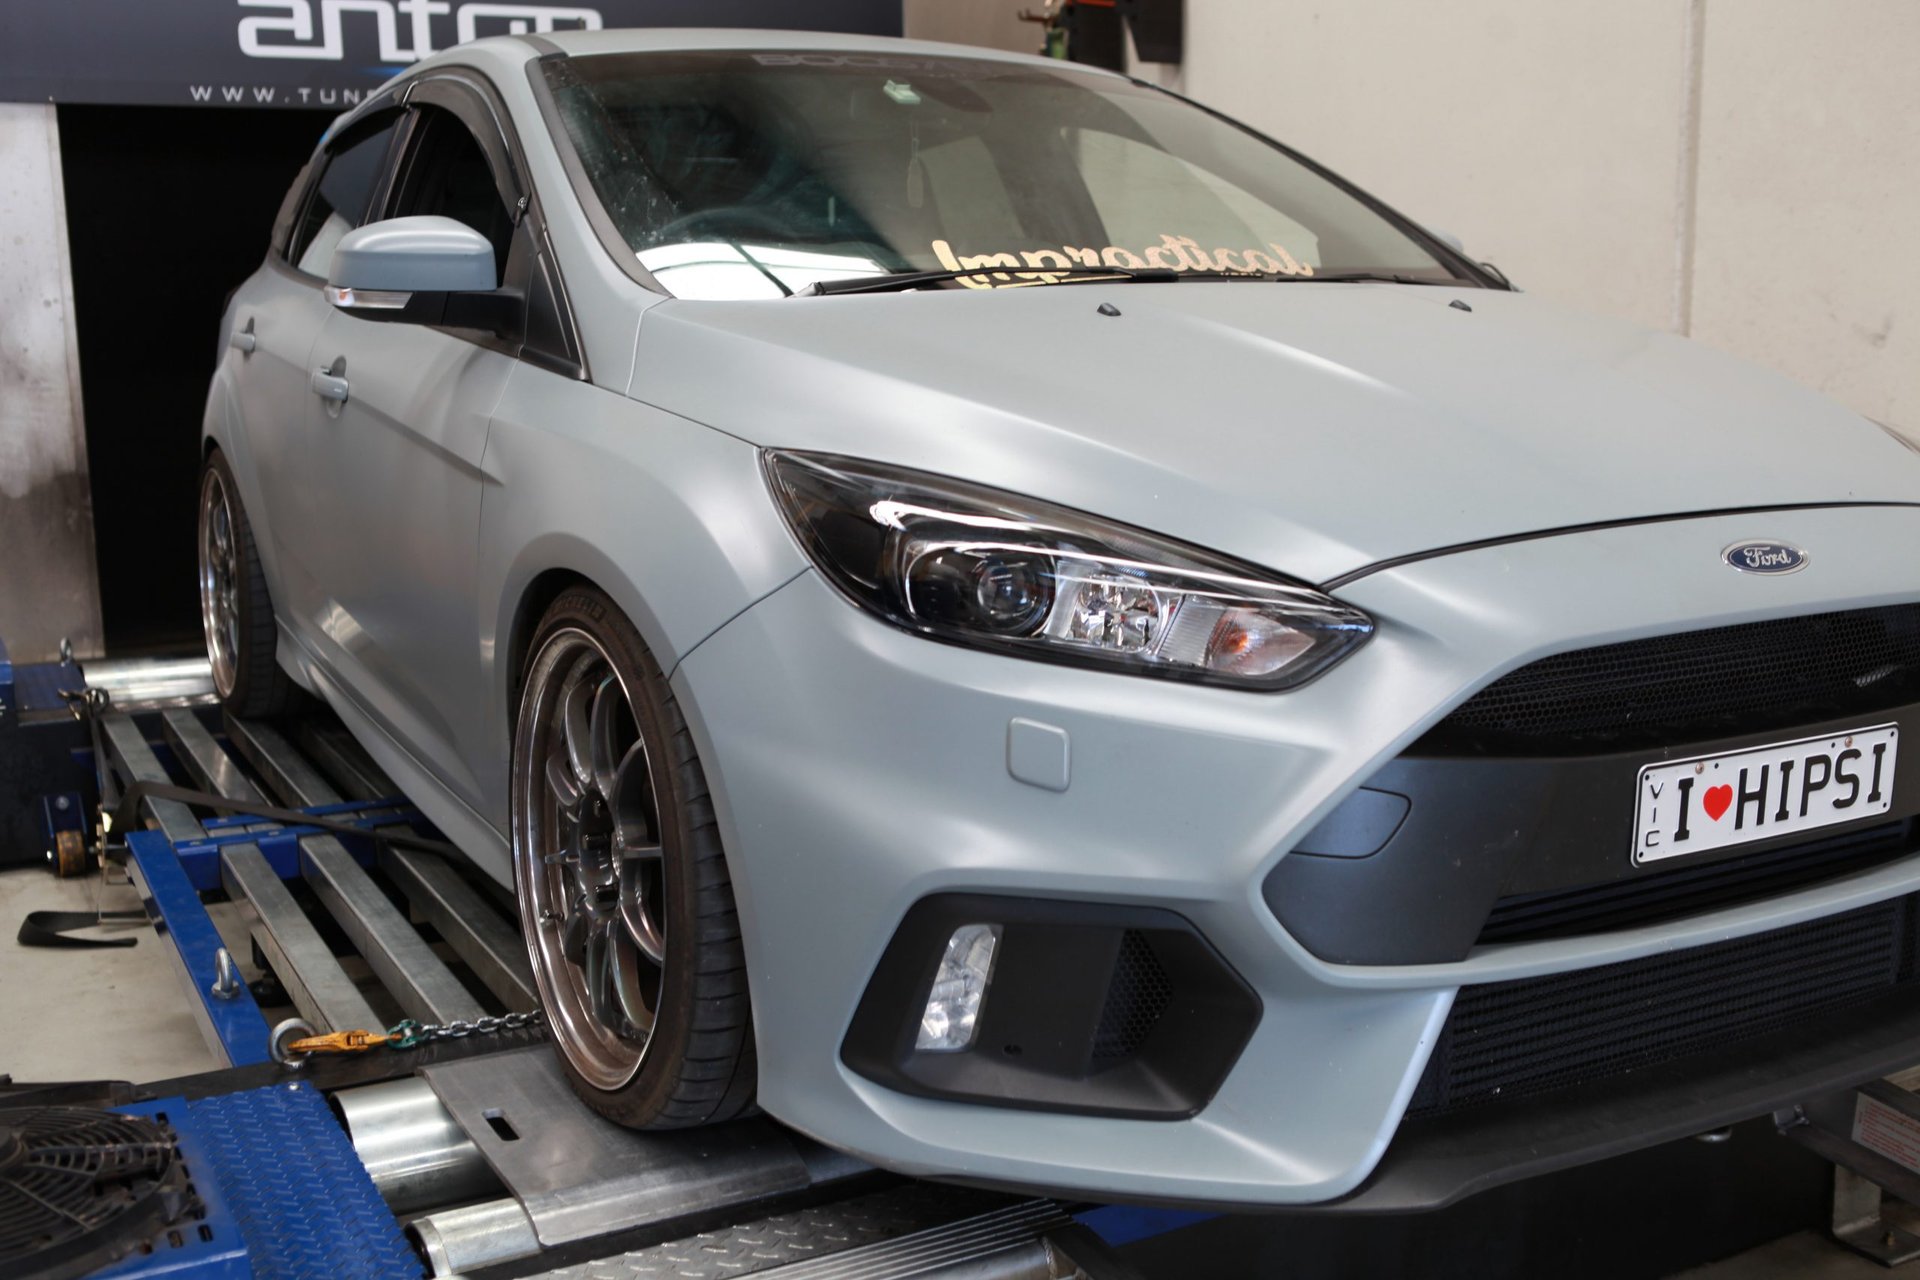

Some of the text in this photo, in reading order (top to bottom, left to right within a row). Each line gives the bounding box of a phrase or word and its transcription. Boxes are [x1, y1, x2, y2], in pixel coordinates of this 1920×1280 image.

[1743, 545, 1792, 568] Ford
[1645, 782, 1664, 847] VIC
[1735, 743, 1886, 830] HIPSI
